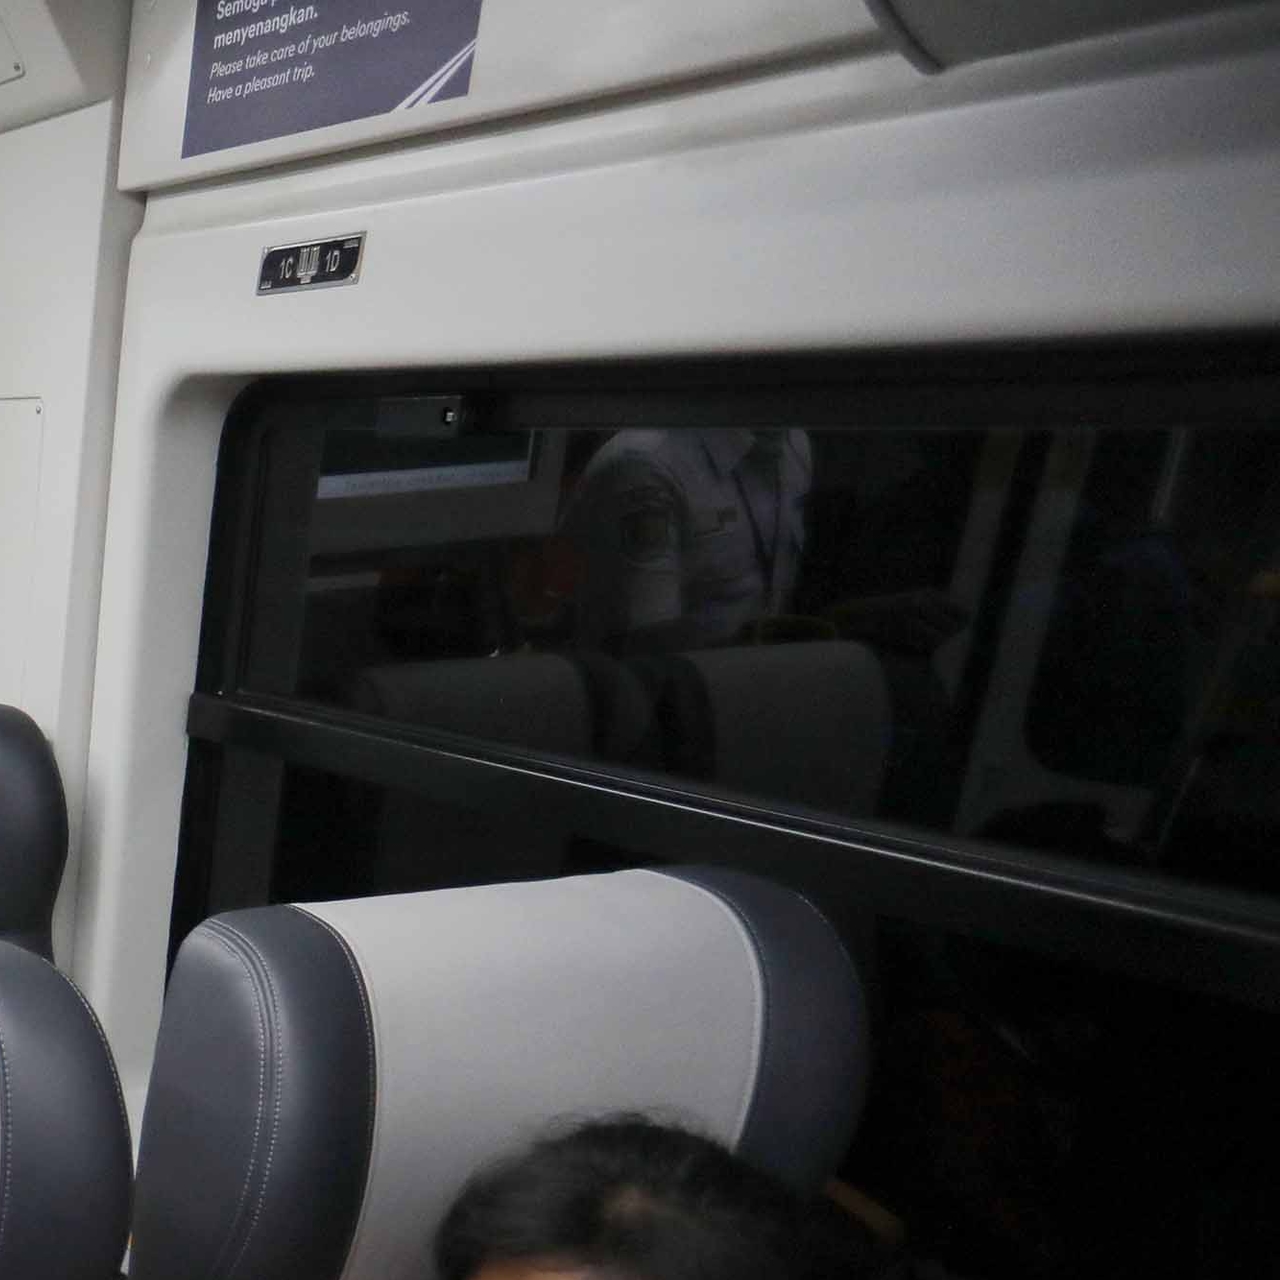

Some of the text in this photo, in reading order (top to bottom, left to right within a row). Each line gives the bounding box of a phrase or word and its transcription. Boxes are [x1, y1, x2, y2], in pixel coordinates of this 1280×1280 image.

[210, 10, 411, 79] Please take care of your belongings.
[214, 5, 318, 49] menyenangkan.
[207, 61, 316, 104] Have a pleasant trip.
[280, 250, 341, 279] 1C 1D
